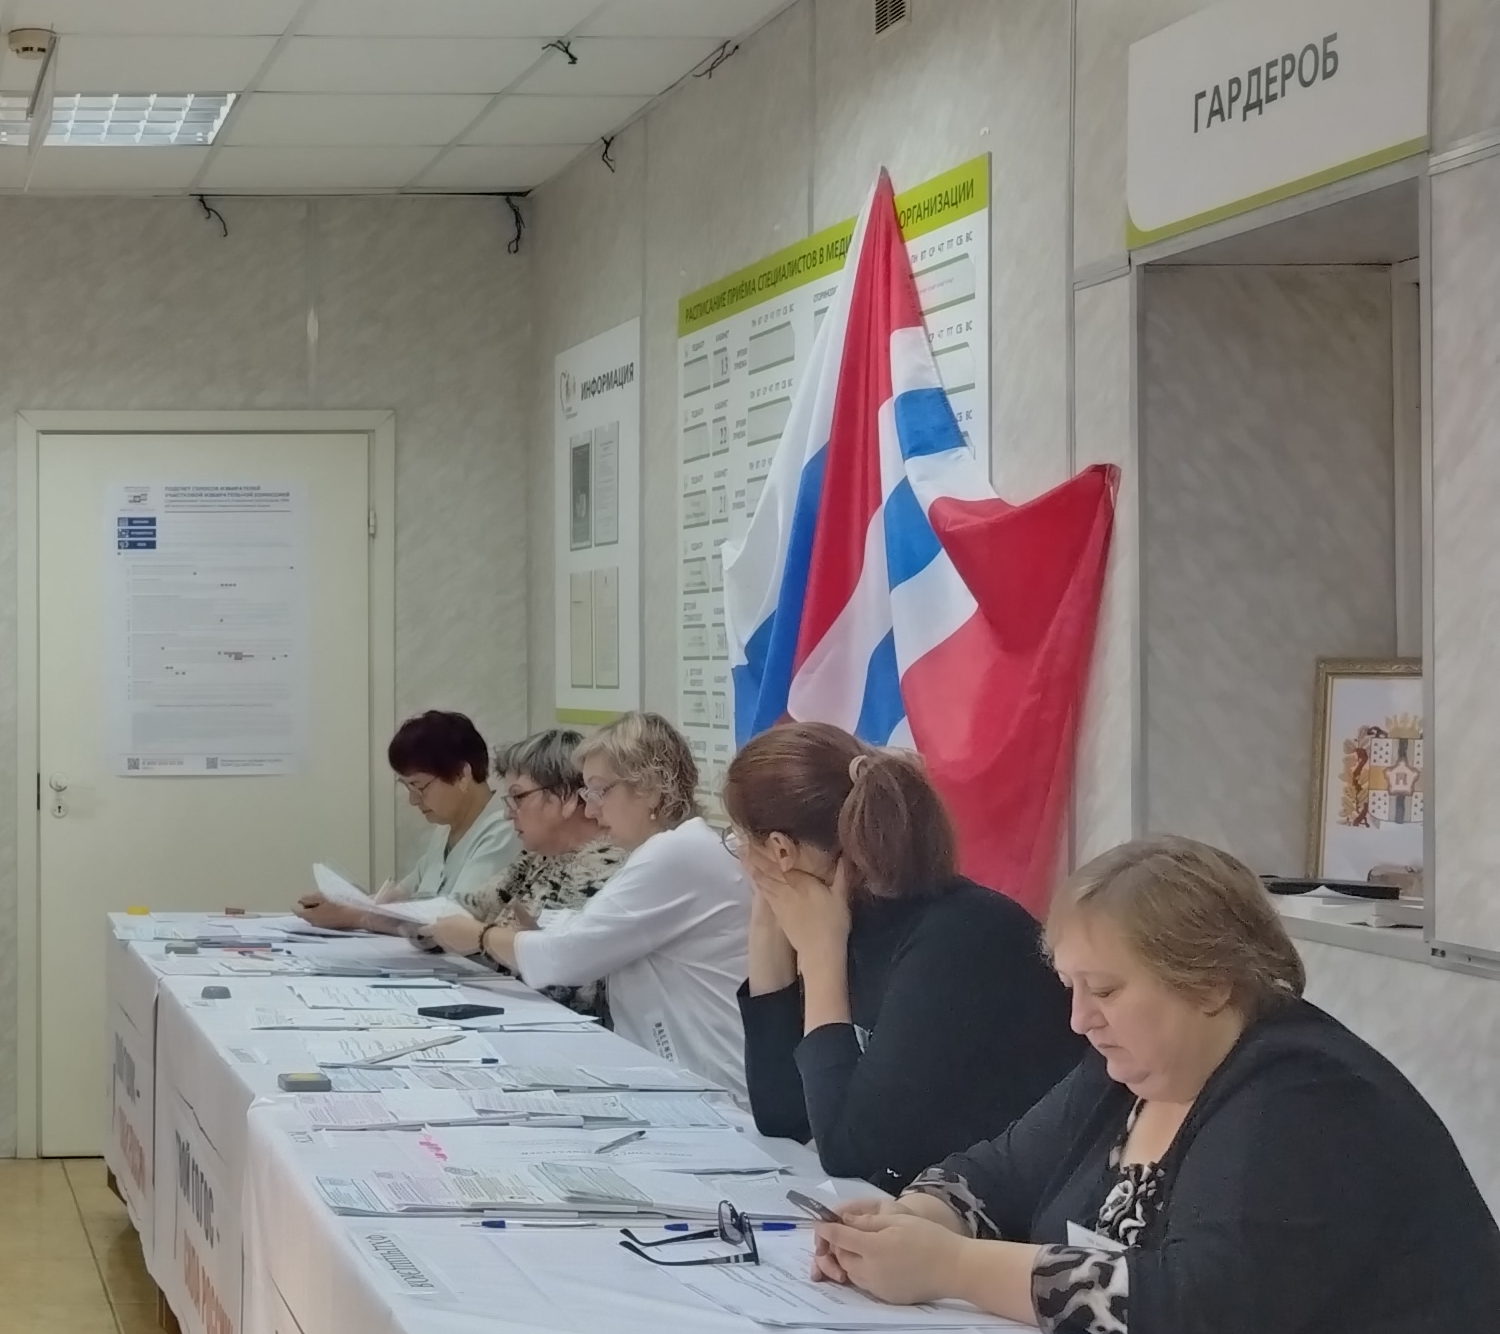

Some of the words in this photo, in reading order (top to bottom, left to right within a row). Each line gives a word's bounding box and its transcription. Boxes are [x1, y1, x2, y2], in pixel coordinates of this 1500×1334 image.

[1194, 32, 1339, 133] ГАРДЕРОБ
[757, 249, 818, 292] СПЕЦИАЛИСТОВ
[819, 248, 825, 265] В
[899, 178, 974, 229] ОРГАНИЗАЦИИ
[581, 362, 634, 401] ИНФОРМАЦИЯ
